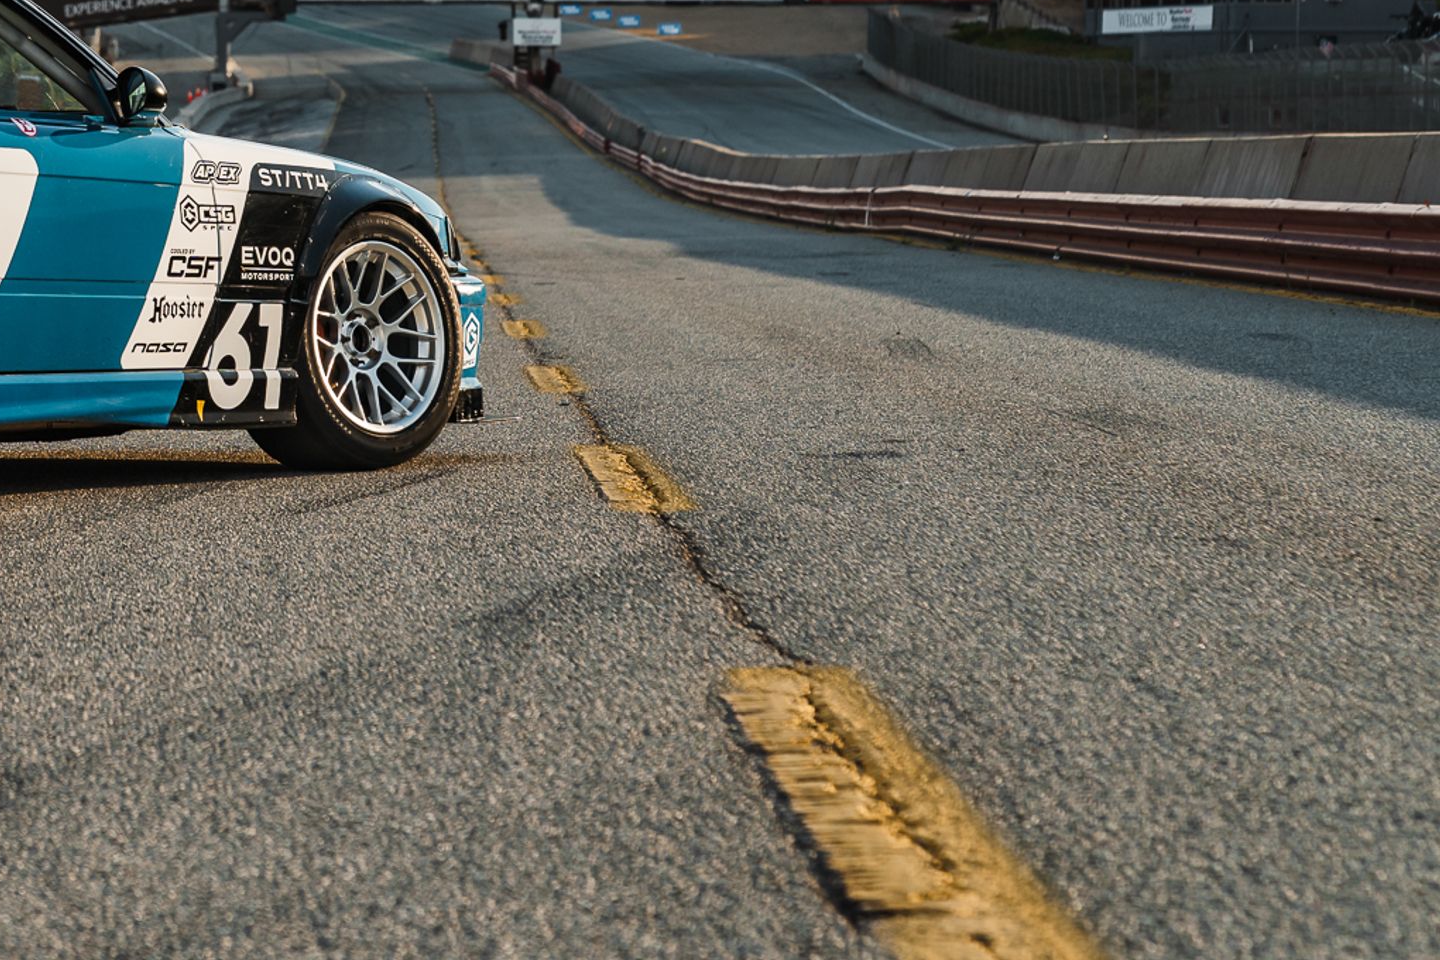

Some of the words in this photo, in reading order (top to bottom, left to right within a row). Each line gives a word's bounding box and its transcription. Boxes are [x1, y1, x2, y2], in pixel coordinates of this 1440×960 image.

[192, 162, 241, 182] APEX
[258, 168, 329, 191] ST/TT4
[199, 205, 235, 223] CSG
[167, 256, 222, 278] CSF
[241, 246, 295, 267] EVOQ
[240, 273, 295, 281] MOTORSPORT
[148, 294, 205, 324] Hoosier
[131, 342, 188, 353] nasa
[205, 303, 284, 411] 61
